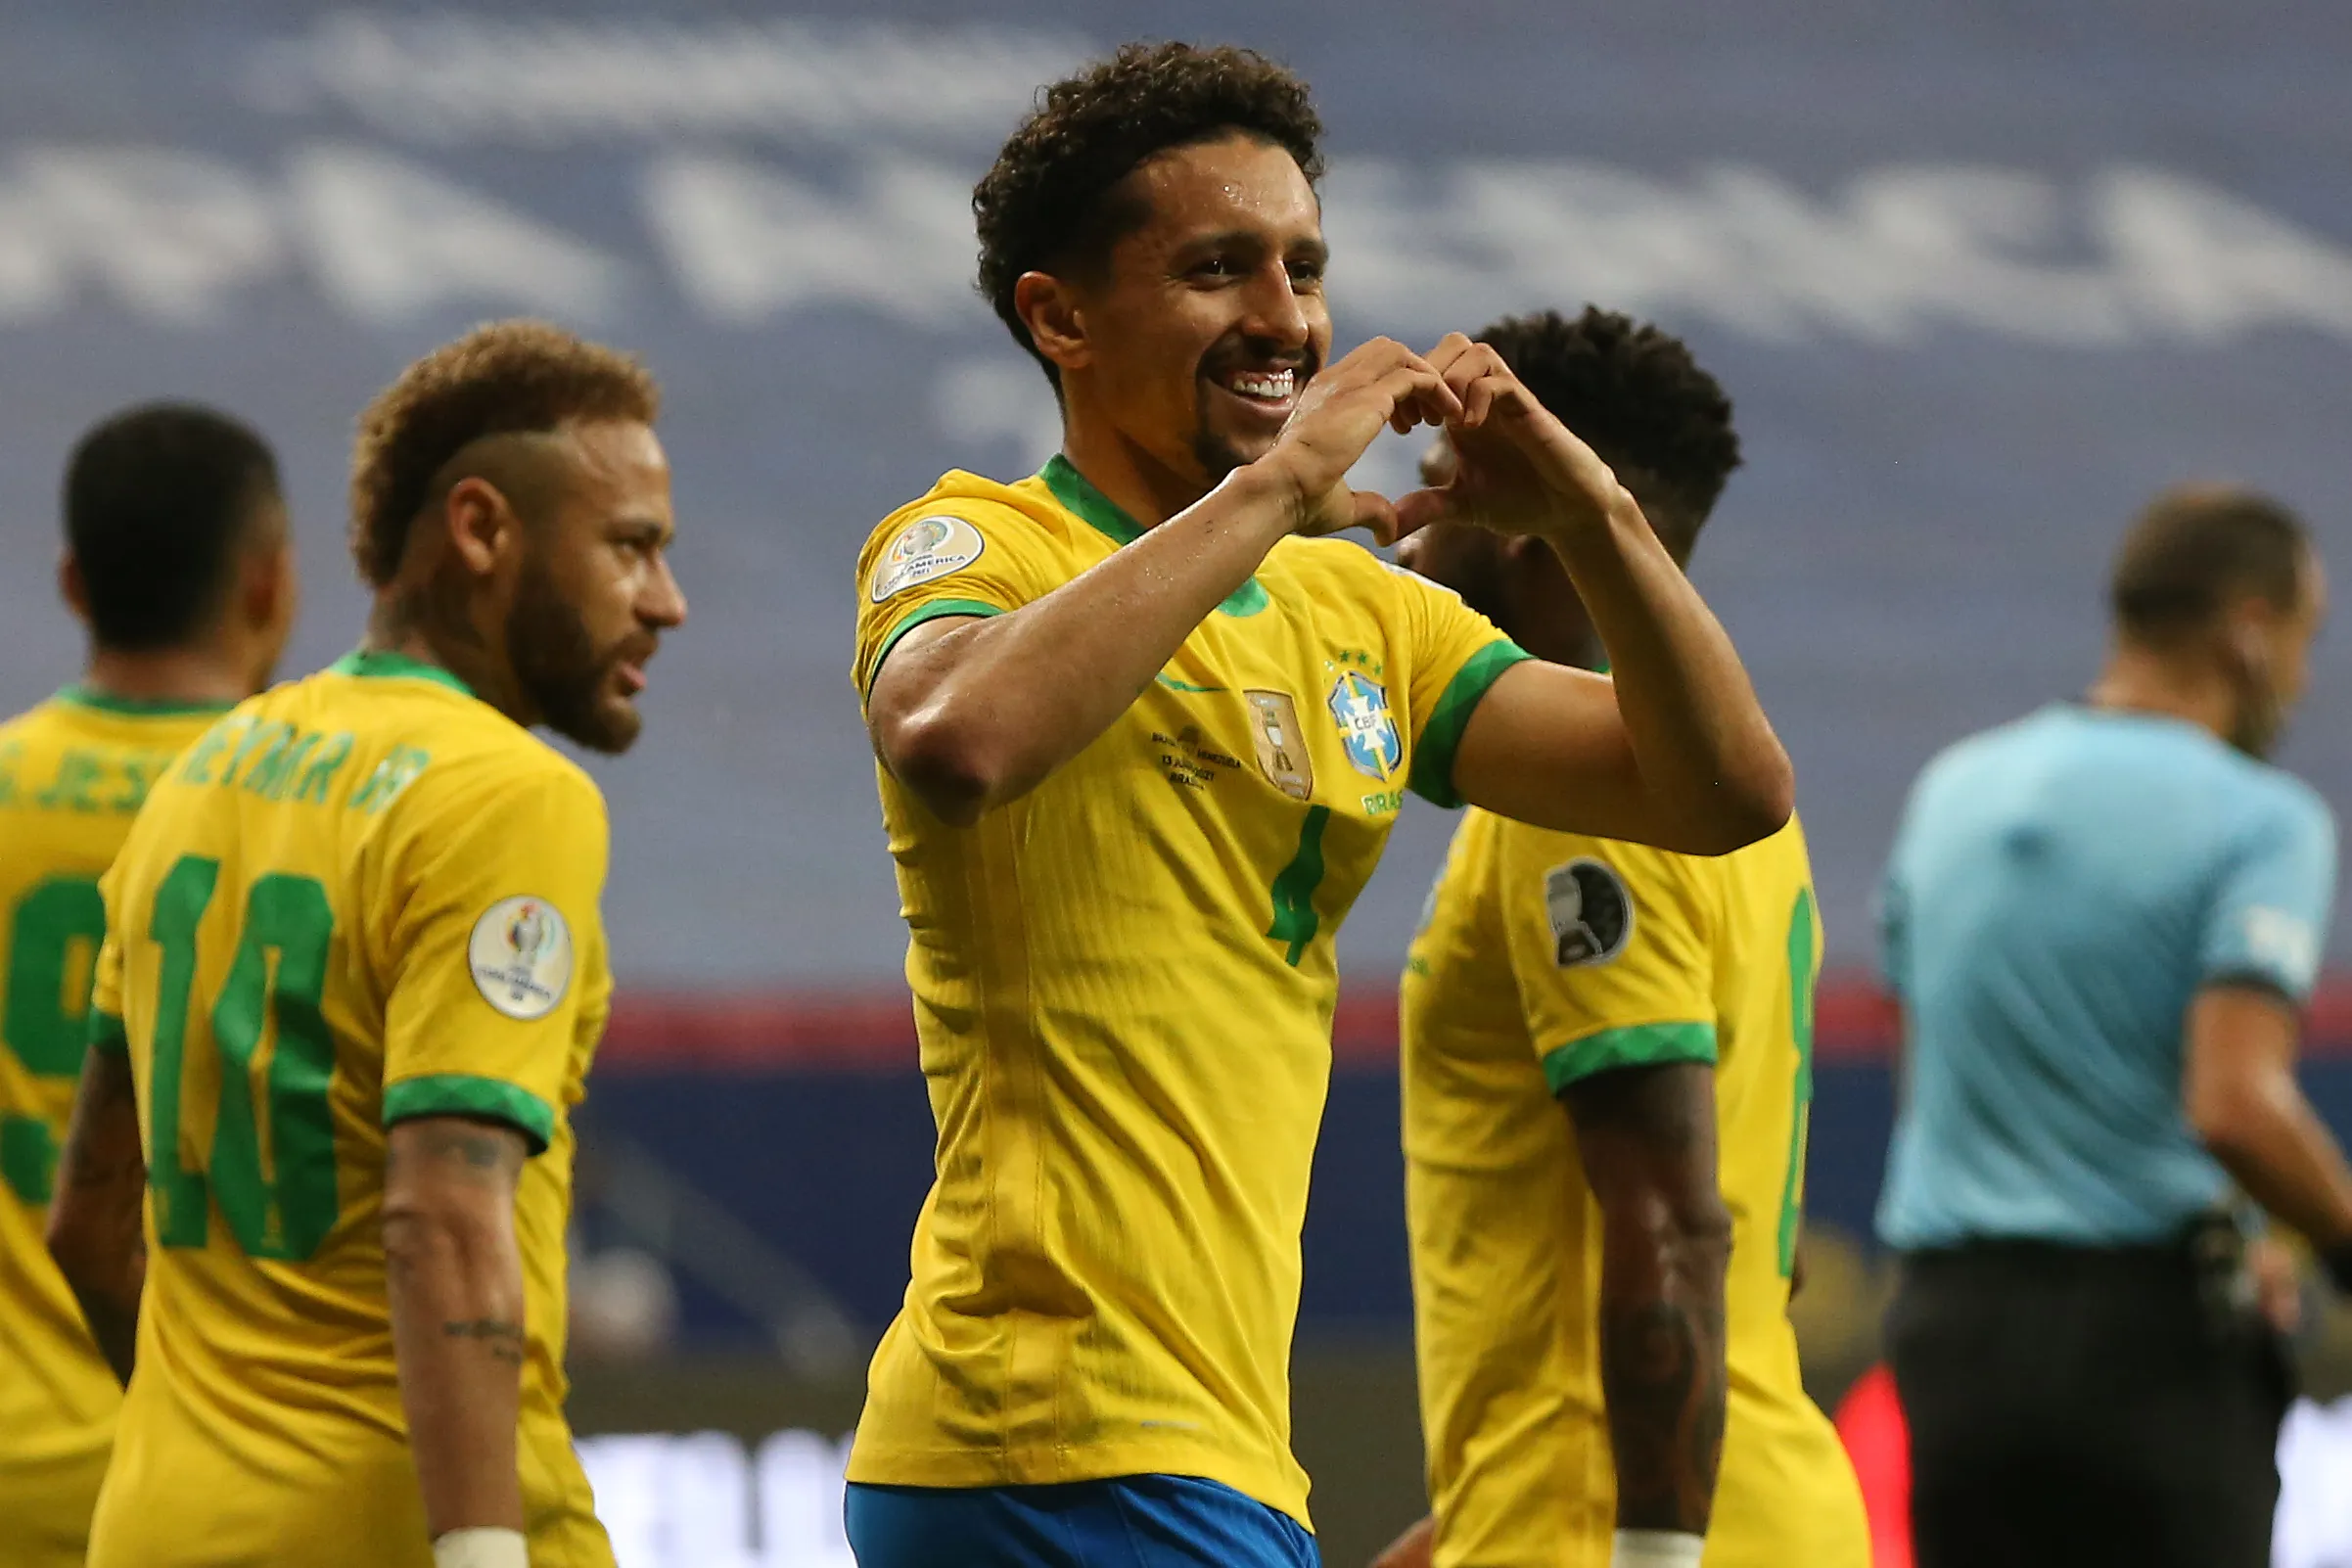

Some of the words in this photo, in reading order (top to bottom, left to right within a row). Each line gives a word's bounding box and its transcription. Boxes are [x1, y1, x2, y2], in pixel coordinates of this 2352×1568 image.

[1355, 714, 1377, 731] CBF
[1266, 804, 1331, 968] 4
[147, 855, 339, 1261] 10
